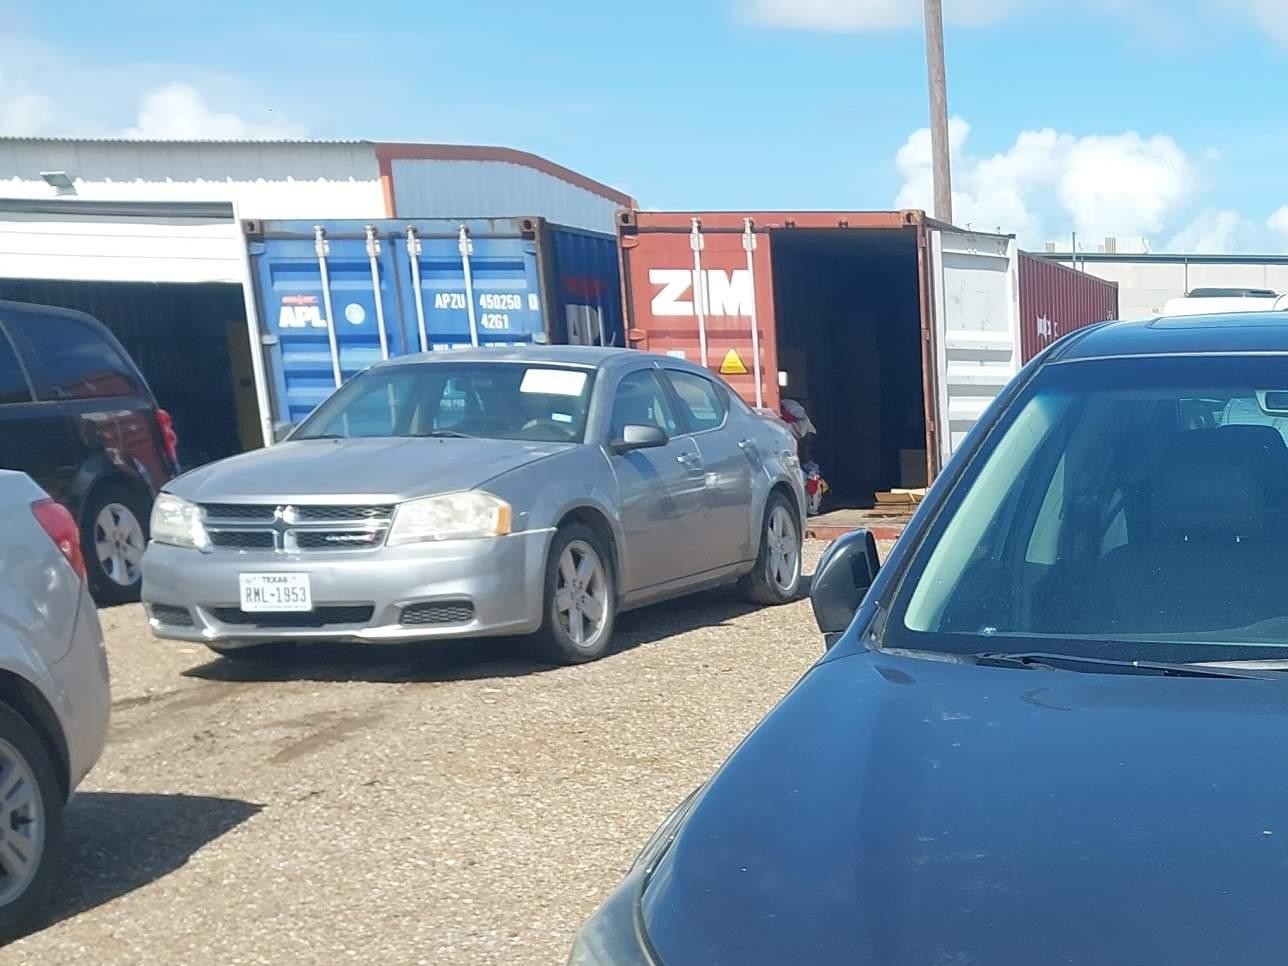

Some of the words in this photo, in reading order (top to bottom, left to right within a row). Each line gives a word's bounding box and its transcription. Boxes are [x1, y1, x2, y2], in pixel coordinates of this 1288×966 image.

[435, 293, 465, 309] APZU
[480, 293, 521, 310] 450250
[649, 270, 752, 316] ZIM
[279, 306, 327, 328] APL
[481, 314, 509, 329] 42G1
[245, 587, 306, 603] RML-1953
